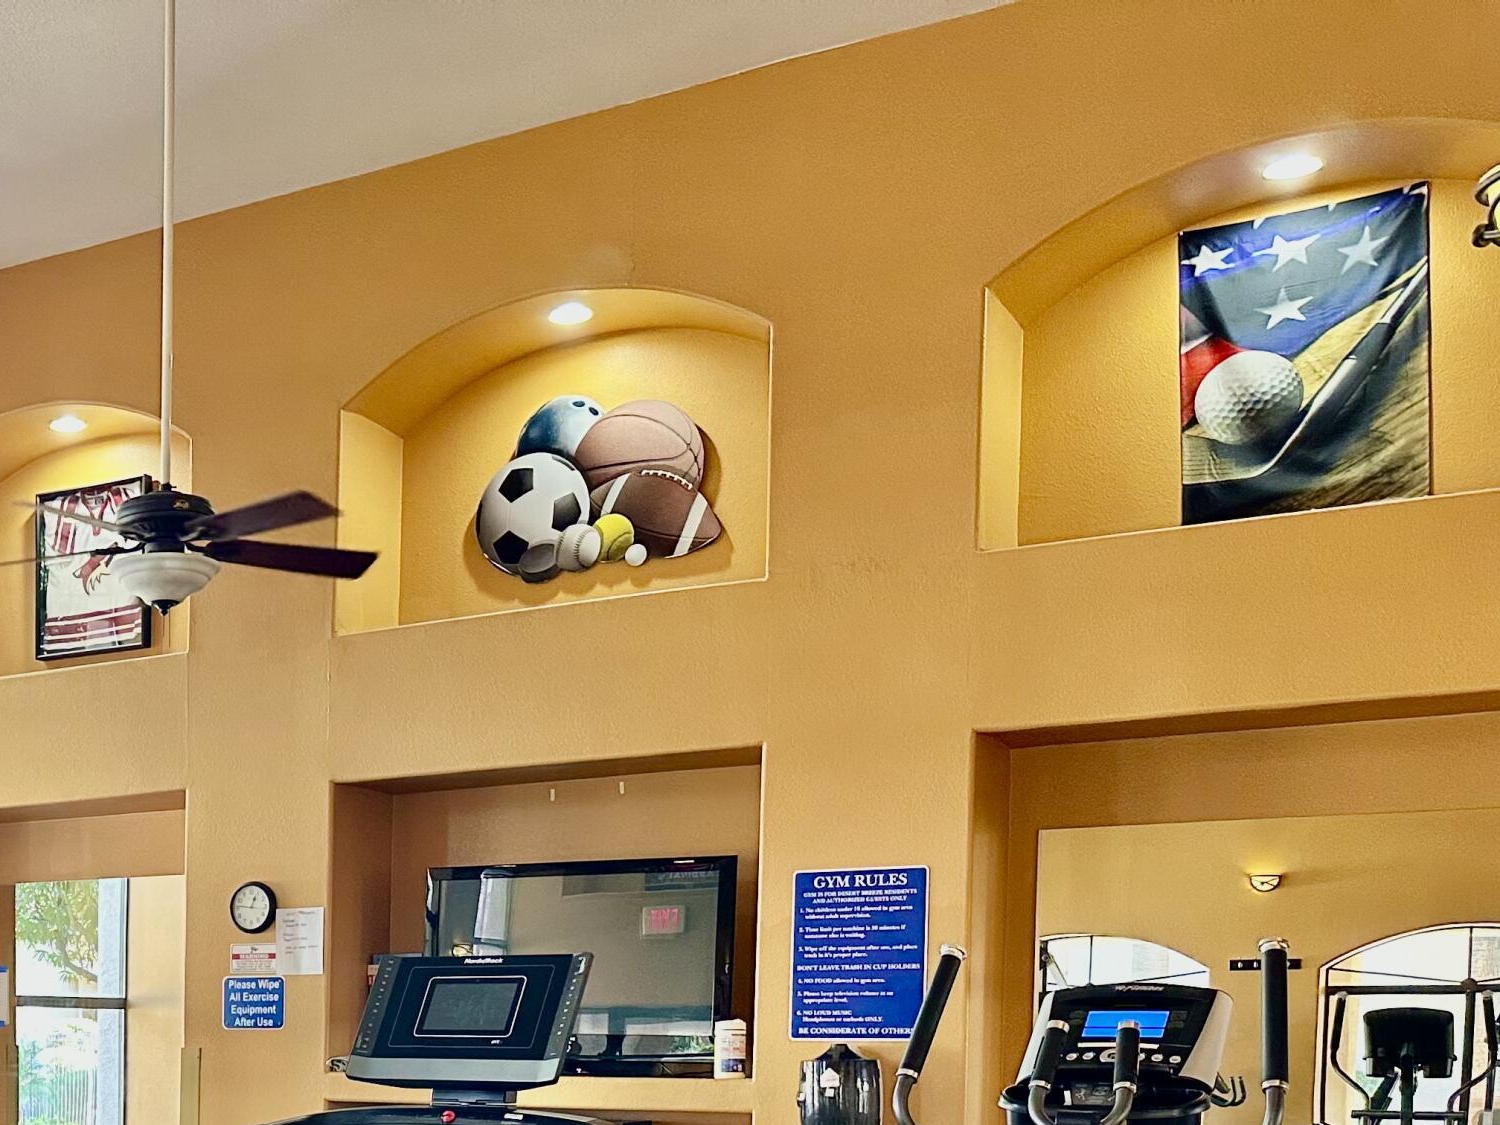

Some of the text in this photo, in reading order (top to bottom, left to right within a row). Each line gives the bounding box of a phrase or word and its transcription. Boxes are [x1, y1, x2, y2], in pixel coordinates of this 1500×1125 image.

[814, 873, 908, 888] GYM RULES
[228, 979, 279, 990] Please Wipe
[229, 992, 279, 1001] All Exercise
[231, 1005, 276, 1016] Equipment
[234, 1017, 273, 1026] After Use
